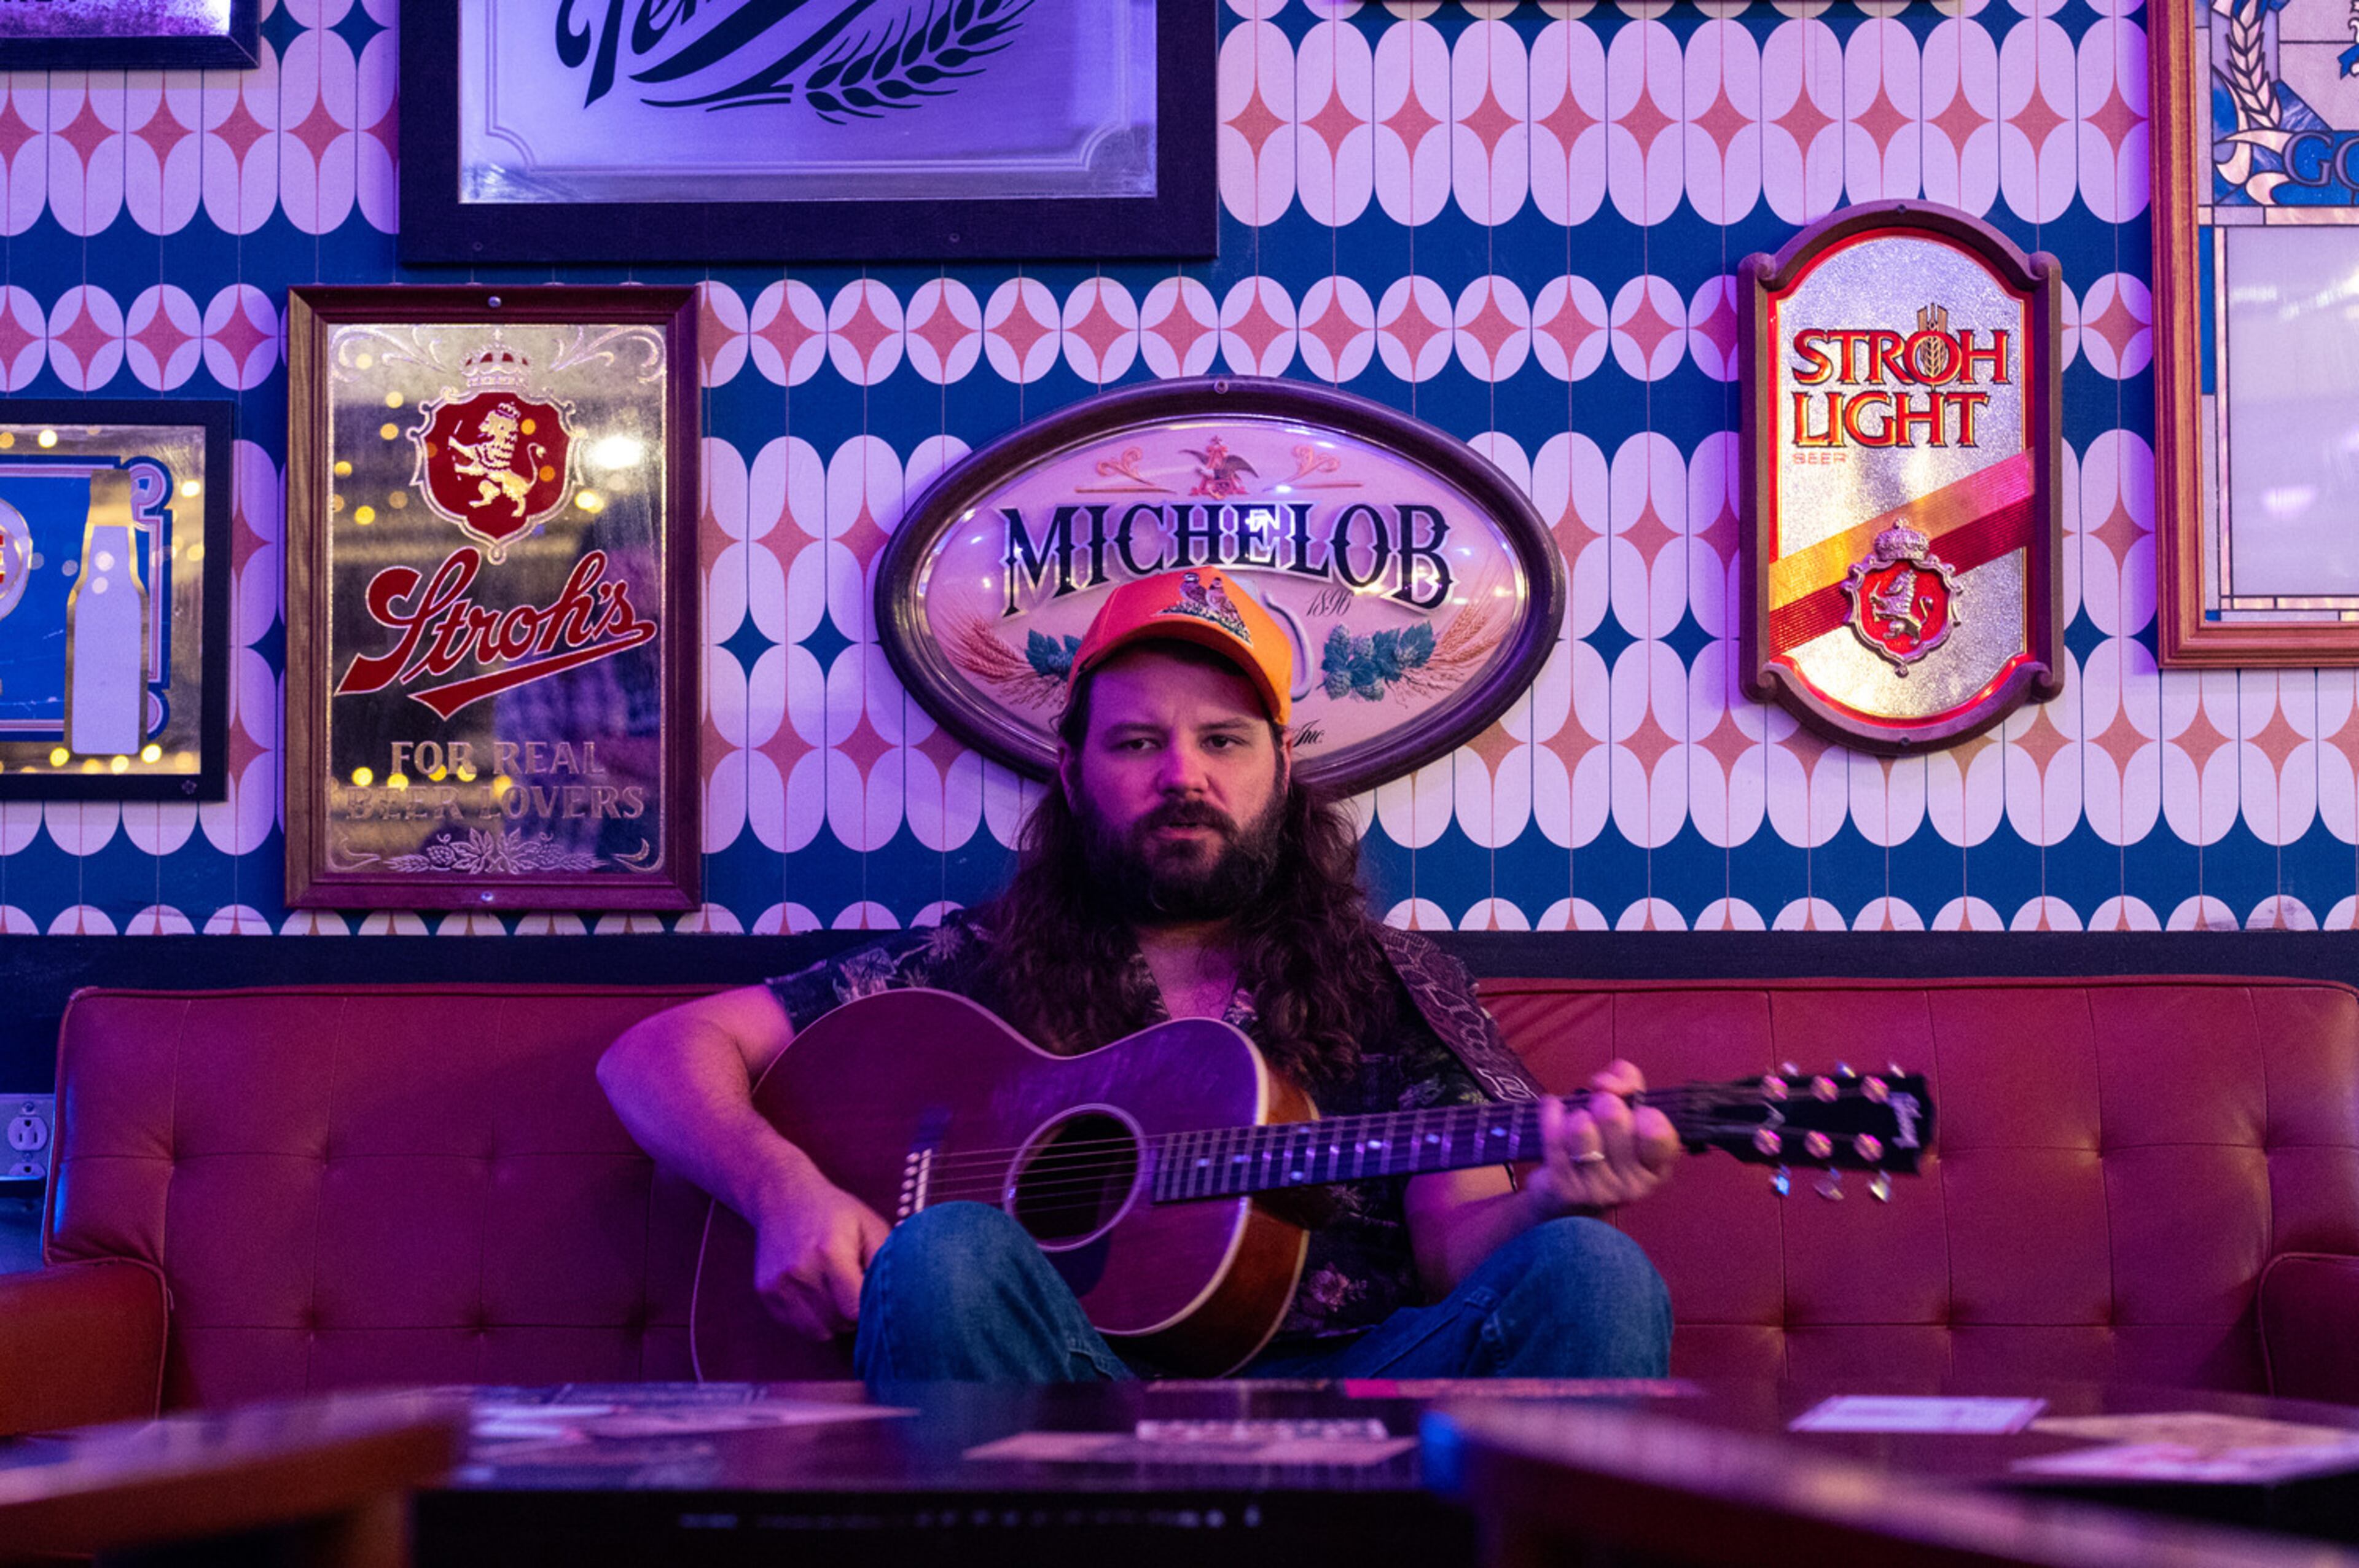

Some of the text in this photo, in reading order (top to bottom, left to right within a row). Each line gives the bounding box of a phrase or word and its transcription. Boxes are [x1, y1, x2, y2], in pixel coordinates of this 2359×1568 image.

[1791, 328, 2012, 386] STROH
[1792, 390, 1990, 448] LIGHT
[1792, 452, 1847, 465] BEER
[998, 502, 1456, 618] MICHELOB
[334, 545, 657, 700] Stroh's
[1306, 588, 1353, 617] 1896
[391, 741, 605, 774] FOR REAL
[346, 786, 644, 819] BEER LOVERS
